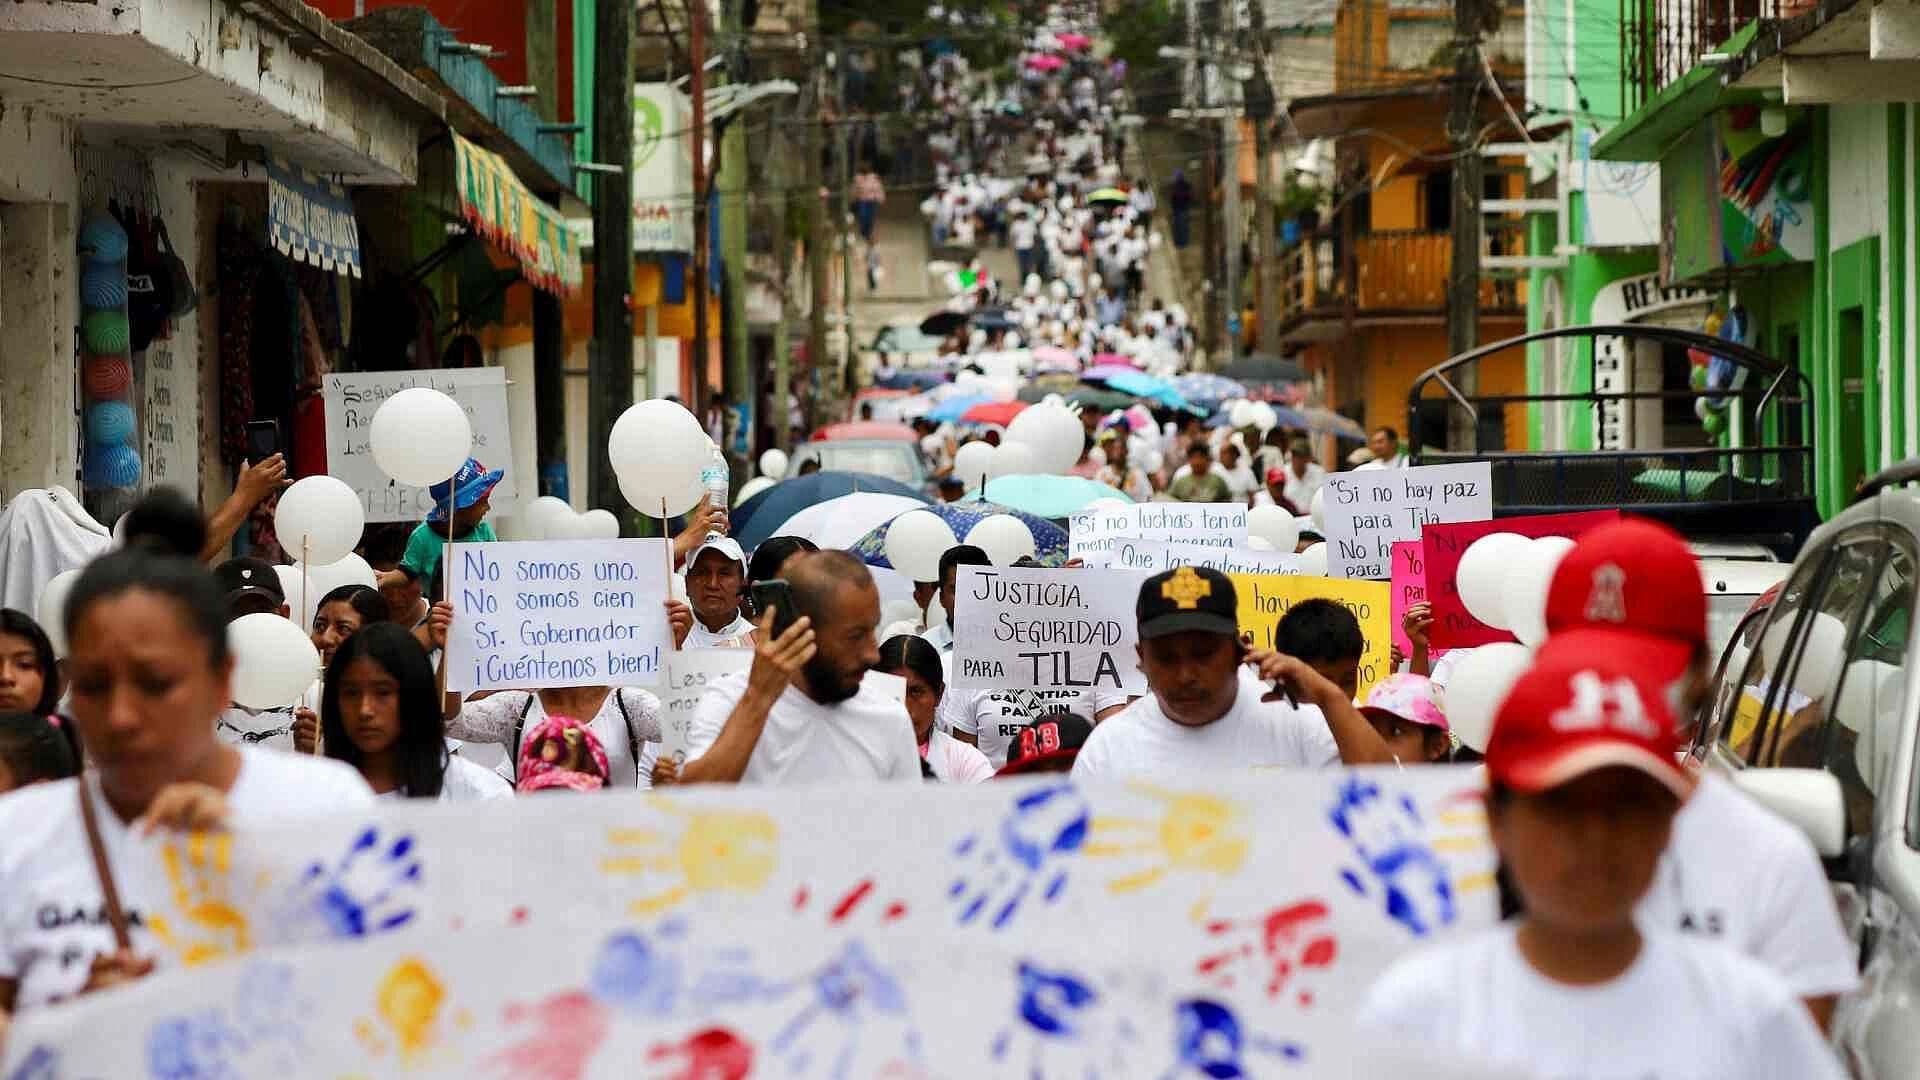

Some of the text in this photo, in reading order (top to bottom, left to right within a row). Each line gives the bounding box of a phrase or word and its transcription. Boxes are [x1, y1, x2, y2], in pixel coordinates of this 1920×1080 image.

[1373, 486, 1393, 502] no
[1405, 478, 1433, 501] hay
[1443, 481, 1478, 503] paz
[1107, 515, 1128, 530] no
[1139, 507, 1193, 530] luchas
[1353, 507, 1440, 536] para Tila
[1121, 544, 1153, 568] Que
[1339, 539, 1367, 560] No
[1403, 550, 1423, 574] Yo
[464, 550, 638, 581] No somos uno.
[1345, 564, 1382, 579] para
[464, 588, 634, 615] No somos cien
[973, 572, 1089, 609] JUSTICIA,
[475, 616, 639, 649] Sr. Gobernador
[994, 612, 1122, 648] SEGURIDAD
[608, 646, 660, 676] bien!
[963, 651, 1122, 688] PARA TILA
